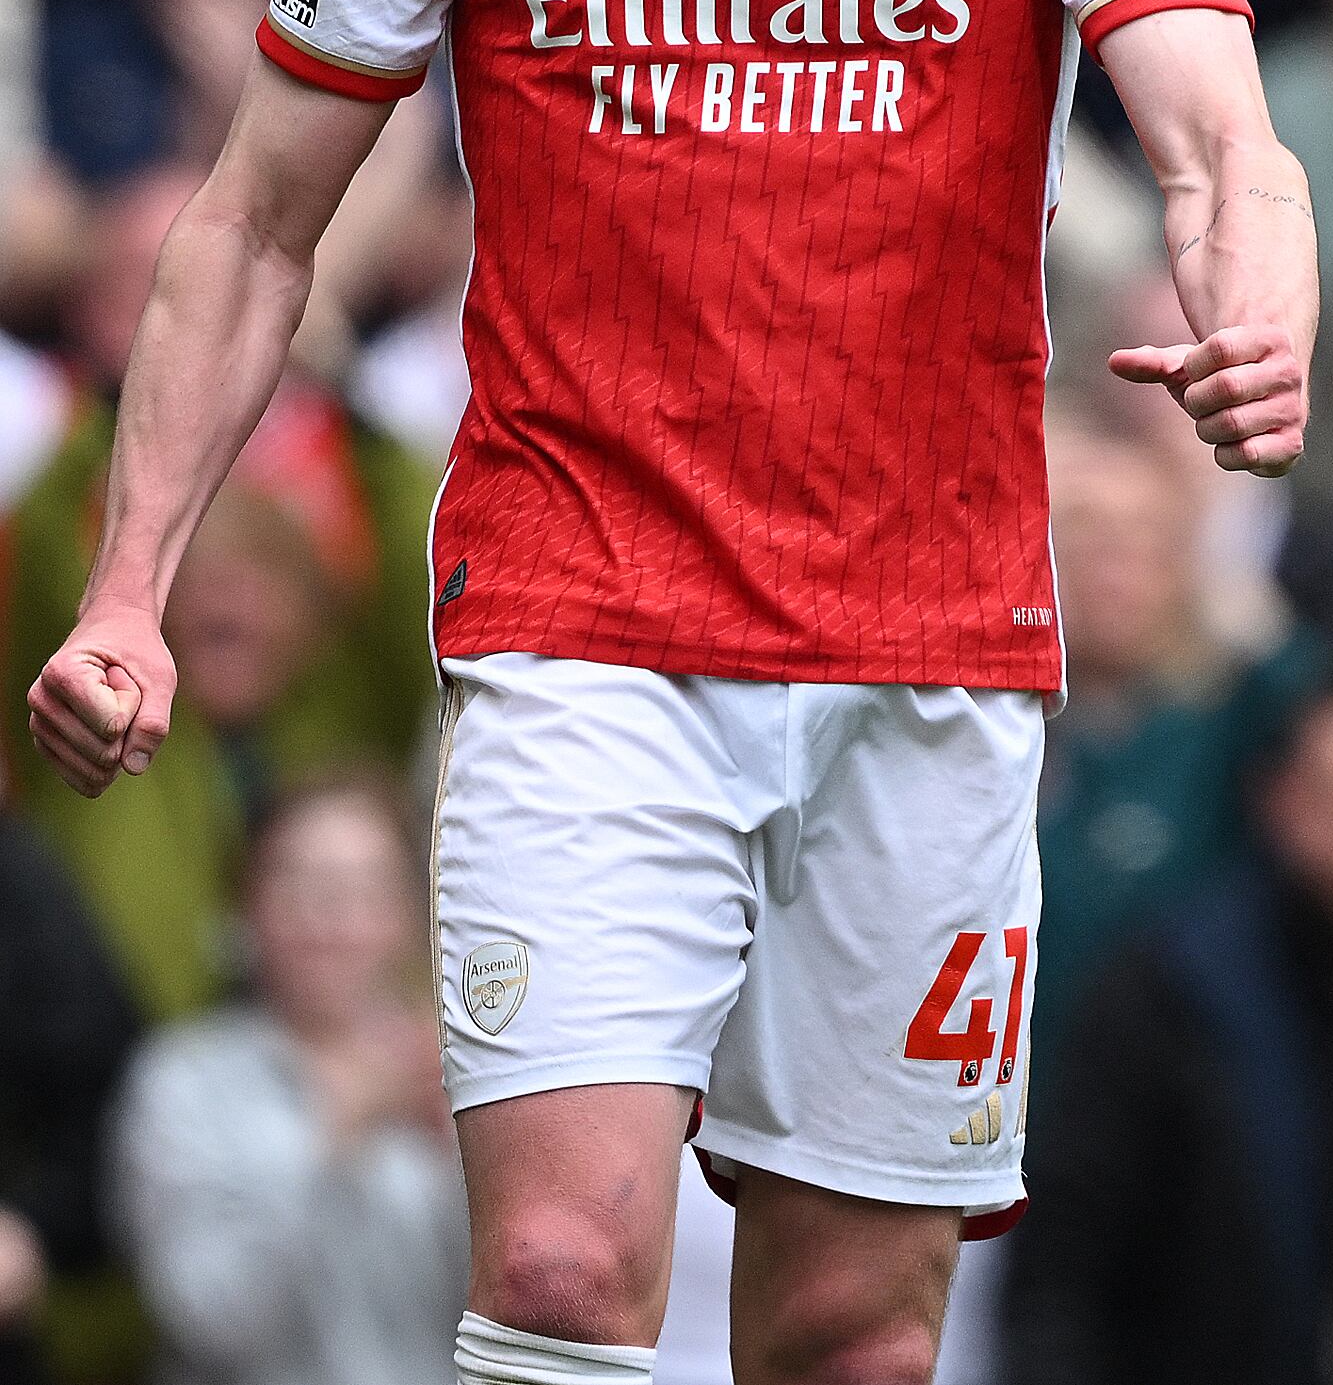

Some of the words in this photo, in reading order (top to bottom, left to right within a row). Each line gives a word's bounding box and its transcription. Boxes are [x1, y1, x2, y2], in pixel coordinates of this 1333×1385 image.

[588, 63, 680, 135] FLY
[700, 59, 903, 134] BETTER
[471, 955, 518, 977] Arsenal
[903, 926, 1027, 1087] 41
